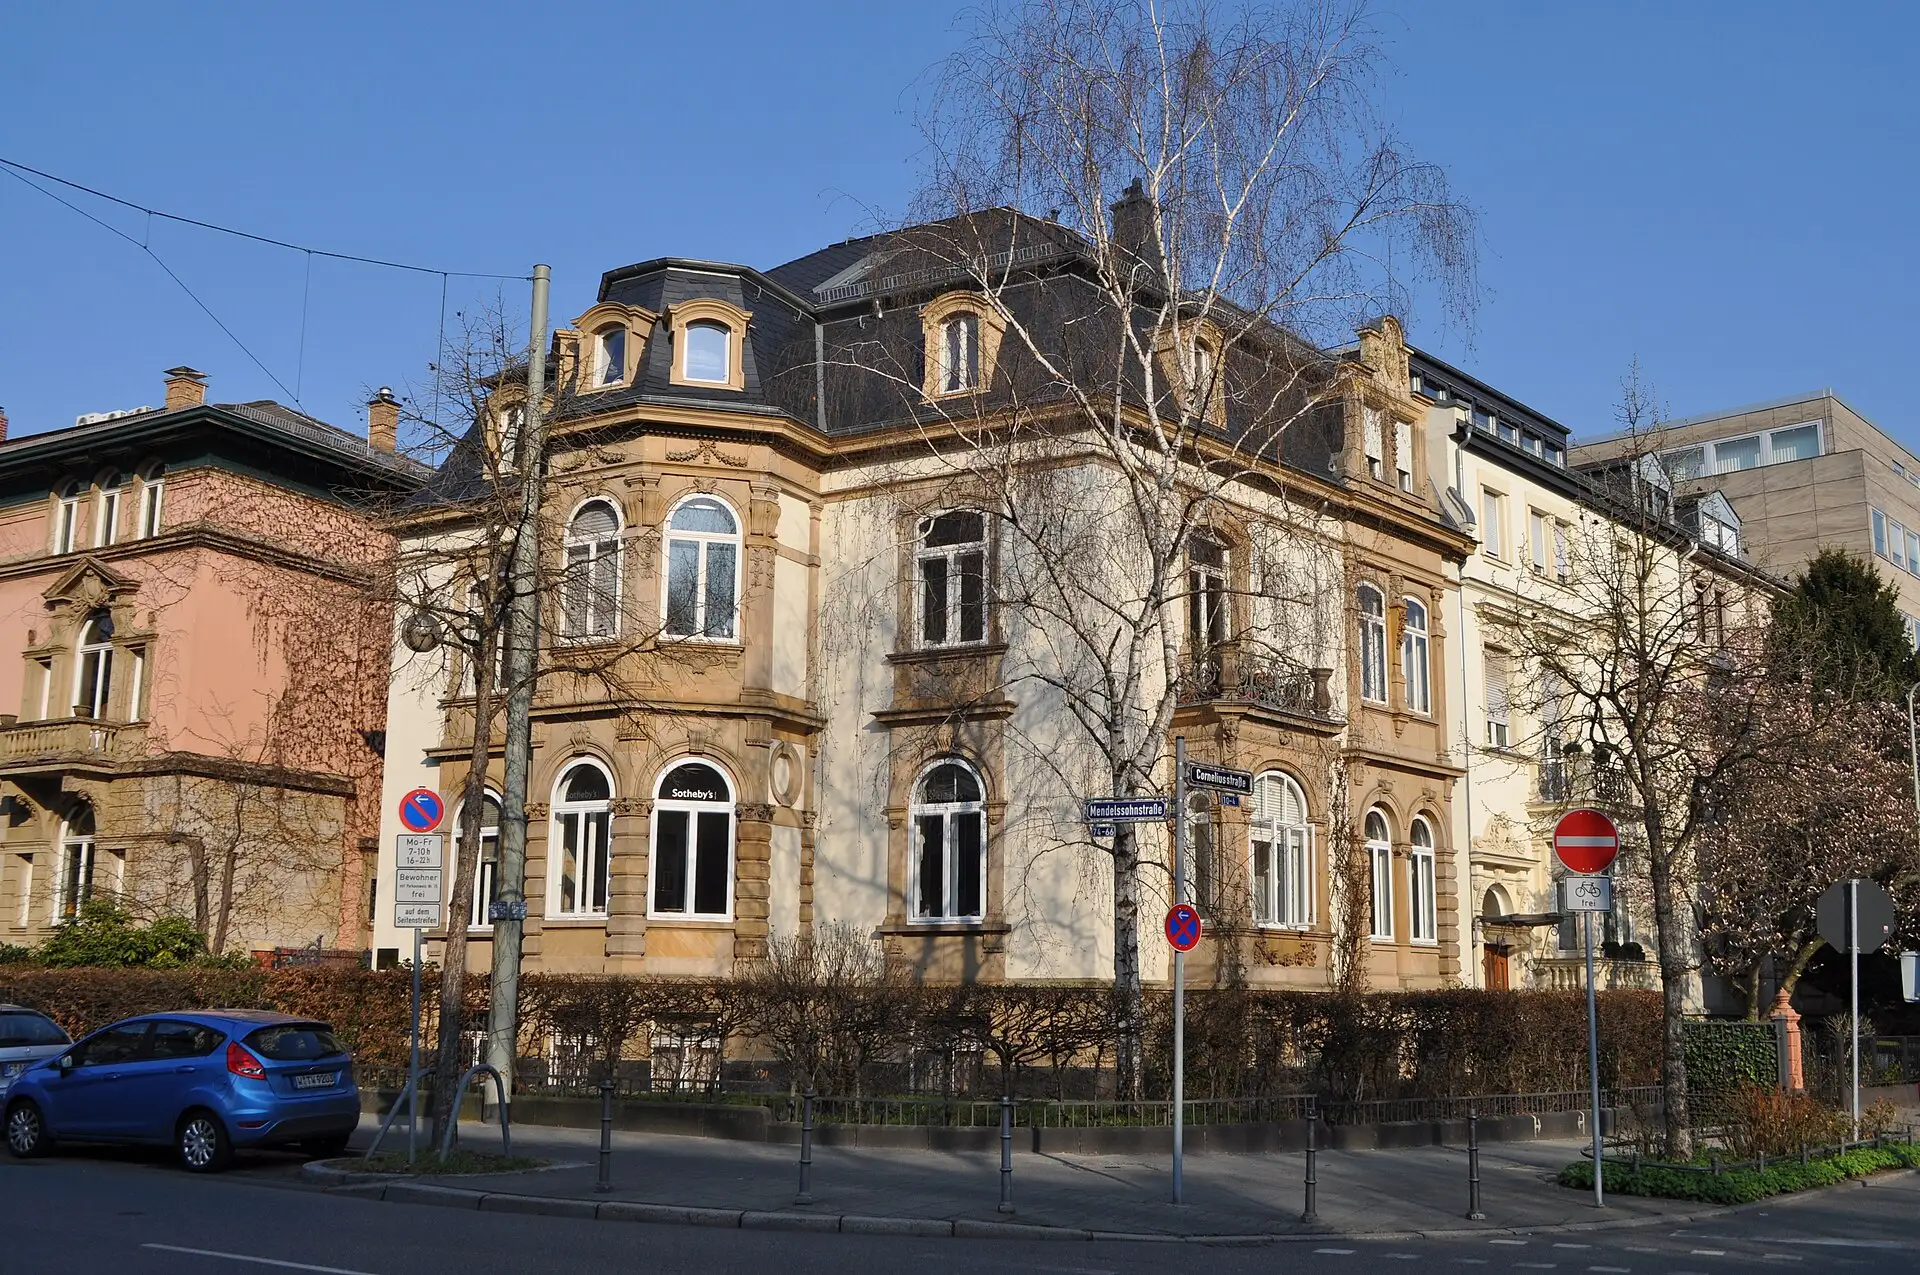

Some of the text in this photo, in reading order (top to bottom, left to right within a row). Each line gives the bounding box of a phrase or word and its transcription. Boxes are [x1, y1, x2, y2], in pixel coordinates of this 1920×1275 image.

[1196, 768, 1247, 788] Corneliusstraße
[671, 788, 714, 800] Sotheby's
[1089, 803, 1163, 817] Mendelssohnstraße
[1093, 827, 1115, 836] 74-66
[406, 838, 433, 846] Mo-Fr
[400, 873, 438, 881] Bewohner
[1581, 899, 1596, 907] frei
[397, 916, 437, 924] Seitenstreifen
